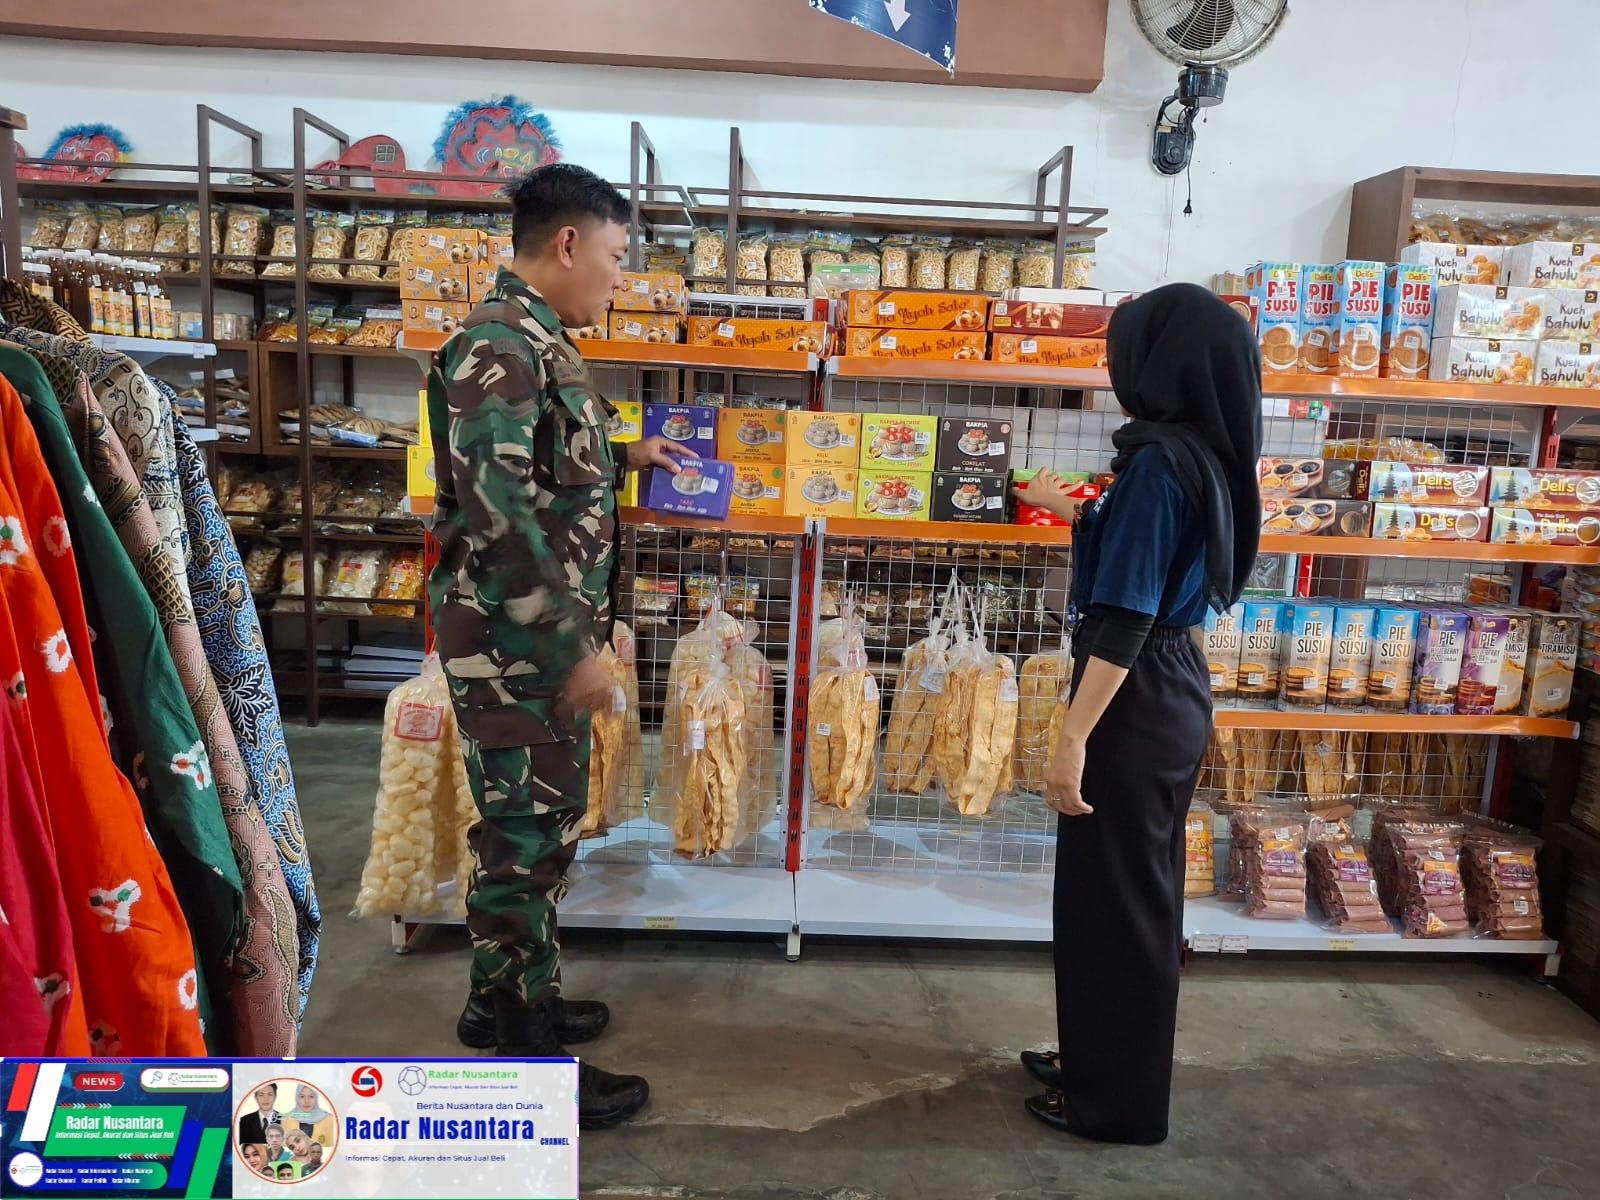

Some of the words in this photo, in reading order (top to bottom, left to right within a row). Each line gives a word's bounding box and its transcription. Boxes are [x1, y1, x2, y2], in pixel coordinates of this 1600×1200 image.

[1434, 256, 1457, 267] Kueh
[1548, 256, 1573, 267] Kueh
[1438, 269, 1462, 282] hulu
[1535, 267, 1578, 281] Bahulu
[1268, 281, 1296, 297] PE
[1350, 281, 1378, 297] PIE
[1403, 284, 1430, 301] PIE
[1265, 300, 1298, 312] SUSU
[1346, 300, 1379, 312] SUSU
[1559, 304, 1586, 315] Kueh
[1460, 310, 1501, 325] Bahulu
[1545, 316, 1591, 330] Bahulu
[1555, 357, 1580, 368] Kueh
[1451, 364, 1495, 378] Bahulu
[1541, 369, 1585, 382] Bahulu
[886, 426, 913, 443] 88
[681, 459, 704, 468] BAKPIA
[1417, 472, 1452, 485] Dell's
[1540, 478, 1575, 492] Dell's
[881, 481, 907, 498] 88
[1216, 618, 1233, 631] PIE
[1256, 619, 1273, 632] PIE
[1304, 622, 1322, 636] PIE
[1346, 624, 1364, 637] PIE
[1389, 626, 1406, 640] PIE
[1439, 631, 1456, 645] PIE
[1480, 632, 1498, 648] PIE
[1553, 633, 1566, 643] PIE
[1209, 635, 1237, 648] SUSU
[1248, 636, 1276, 650] SUSU
[1297, 639, 1326, 654] SUSU
[1339, 641, 1368, 655] SUSU
[1540, 643, 1576, 654] TIRAMISU
[1381, 642, 1411, 657] SUSU
